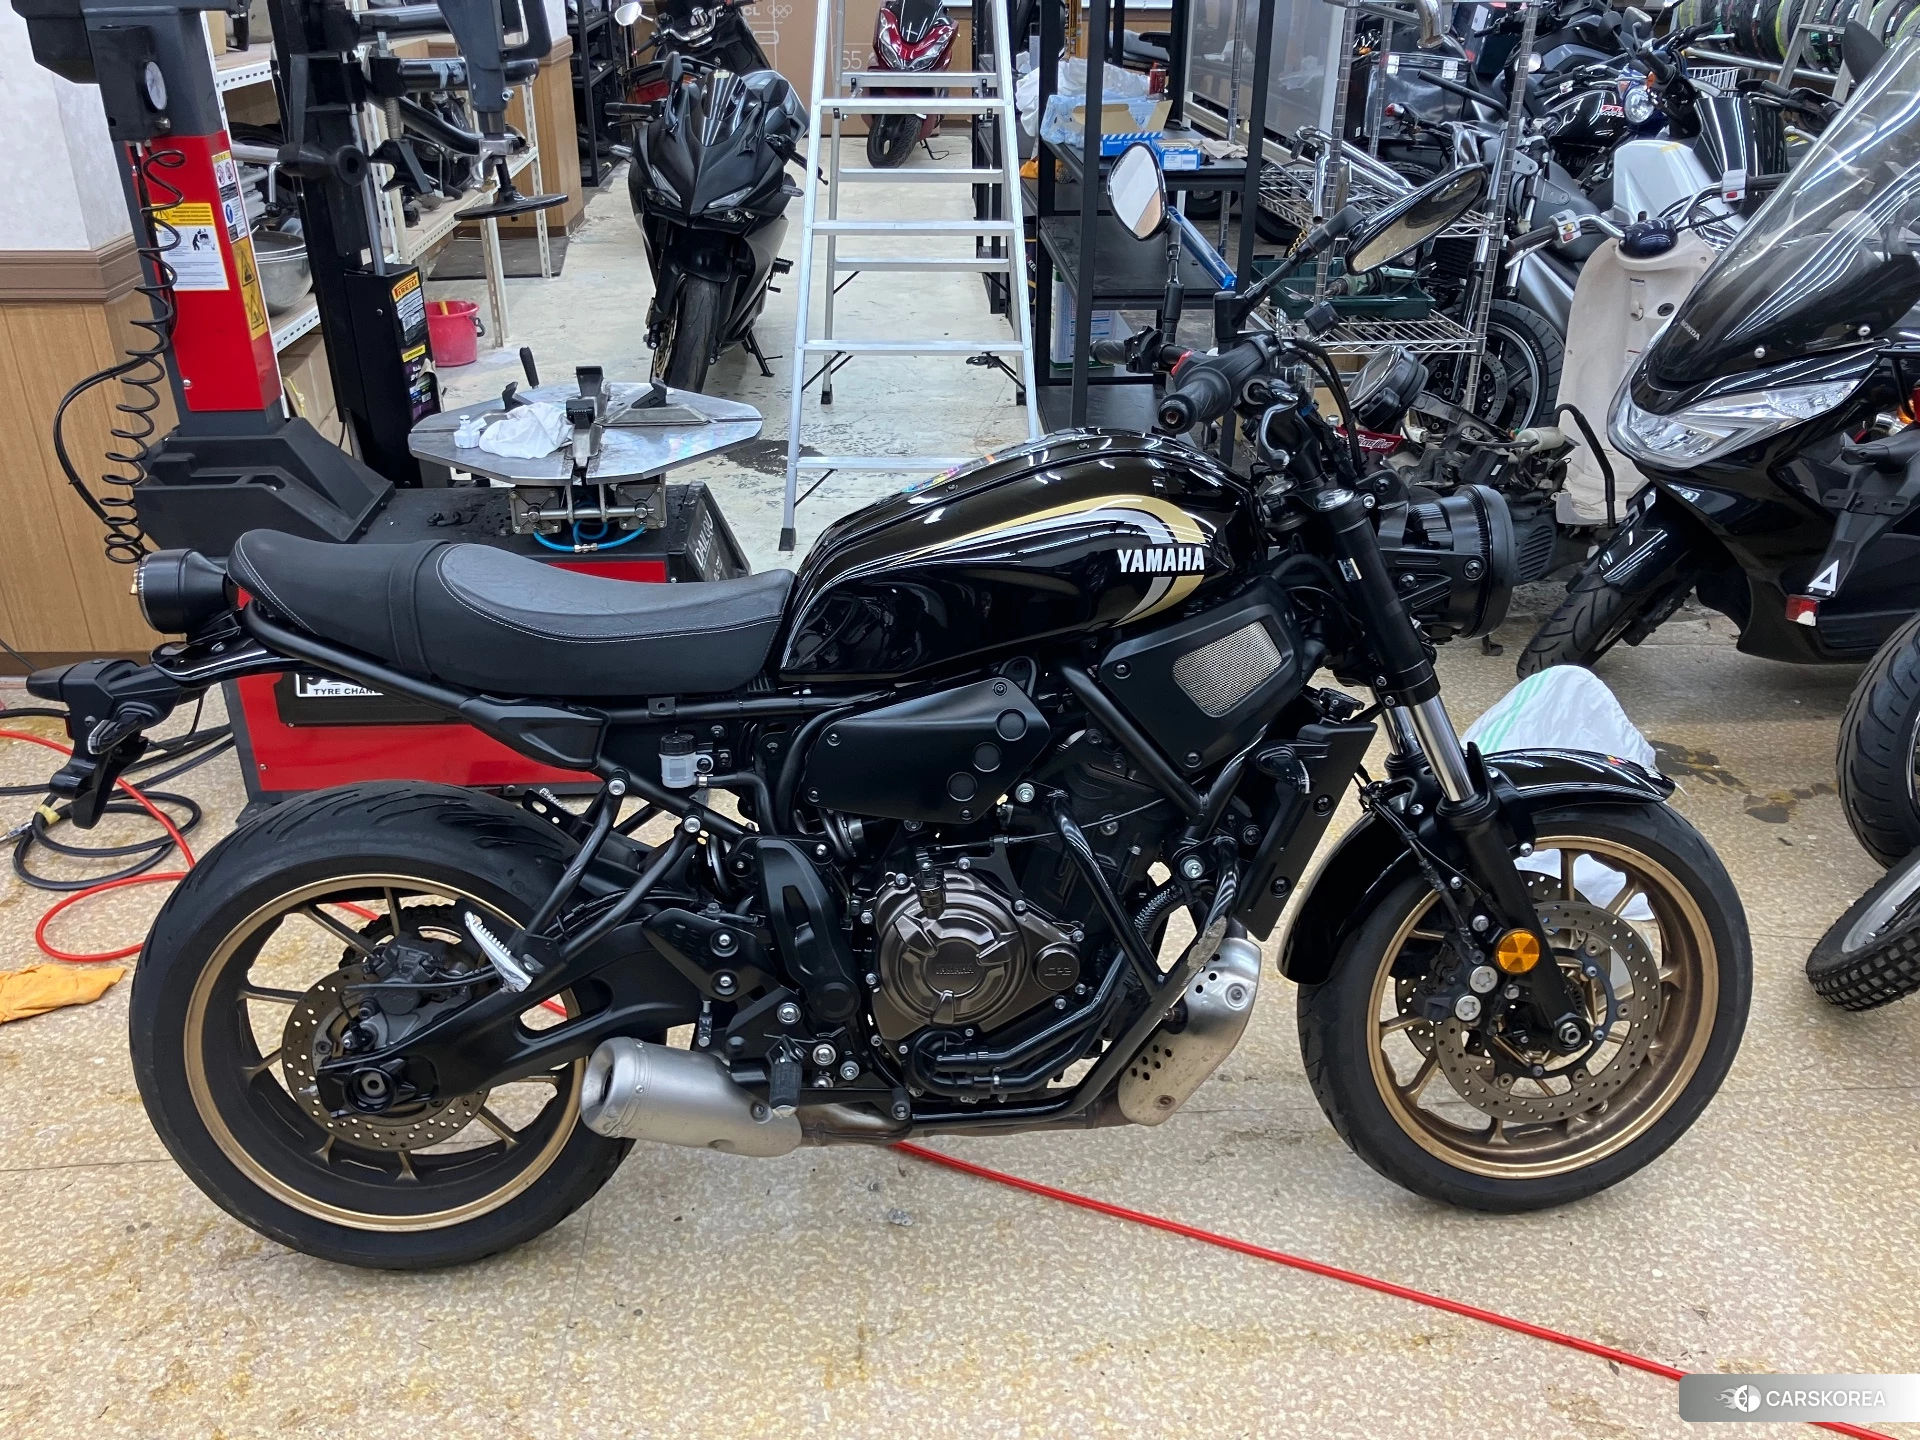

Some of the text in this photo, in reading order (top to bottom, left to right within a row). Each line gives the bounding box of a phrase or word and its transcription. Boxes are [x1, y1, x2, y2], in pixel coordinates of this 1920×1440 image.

[742, 6, 761, 16] CL
[1680, 318, 1700, 341] HONDA
[1117, 547, 1205, 573] YAMAHA
[344, 687, 375, 695] CHAN
